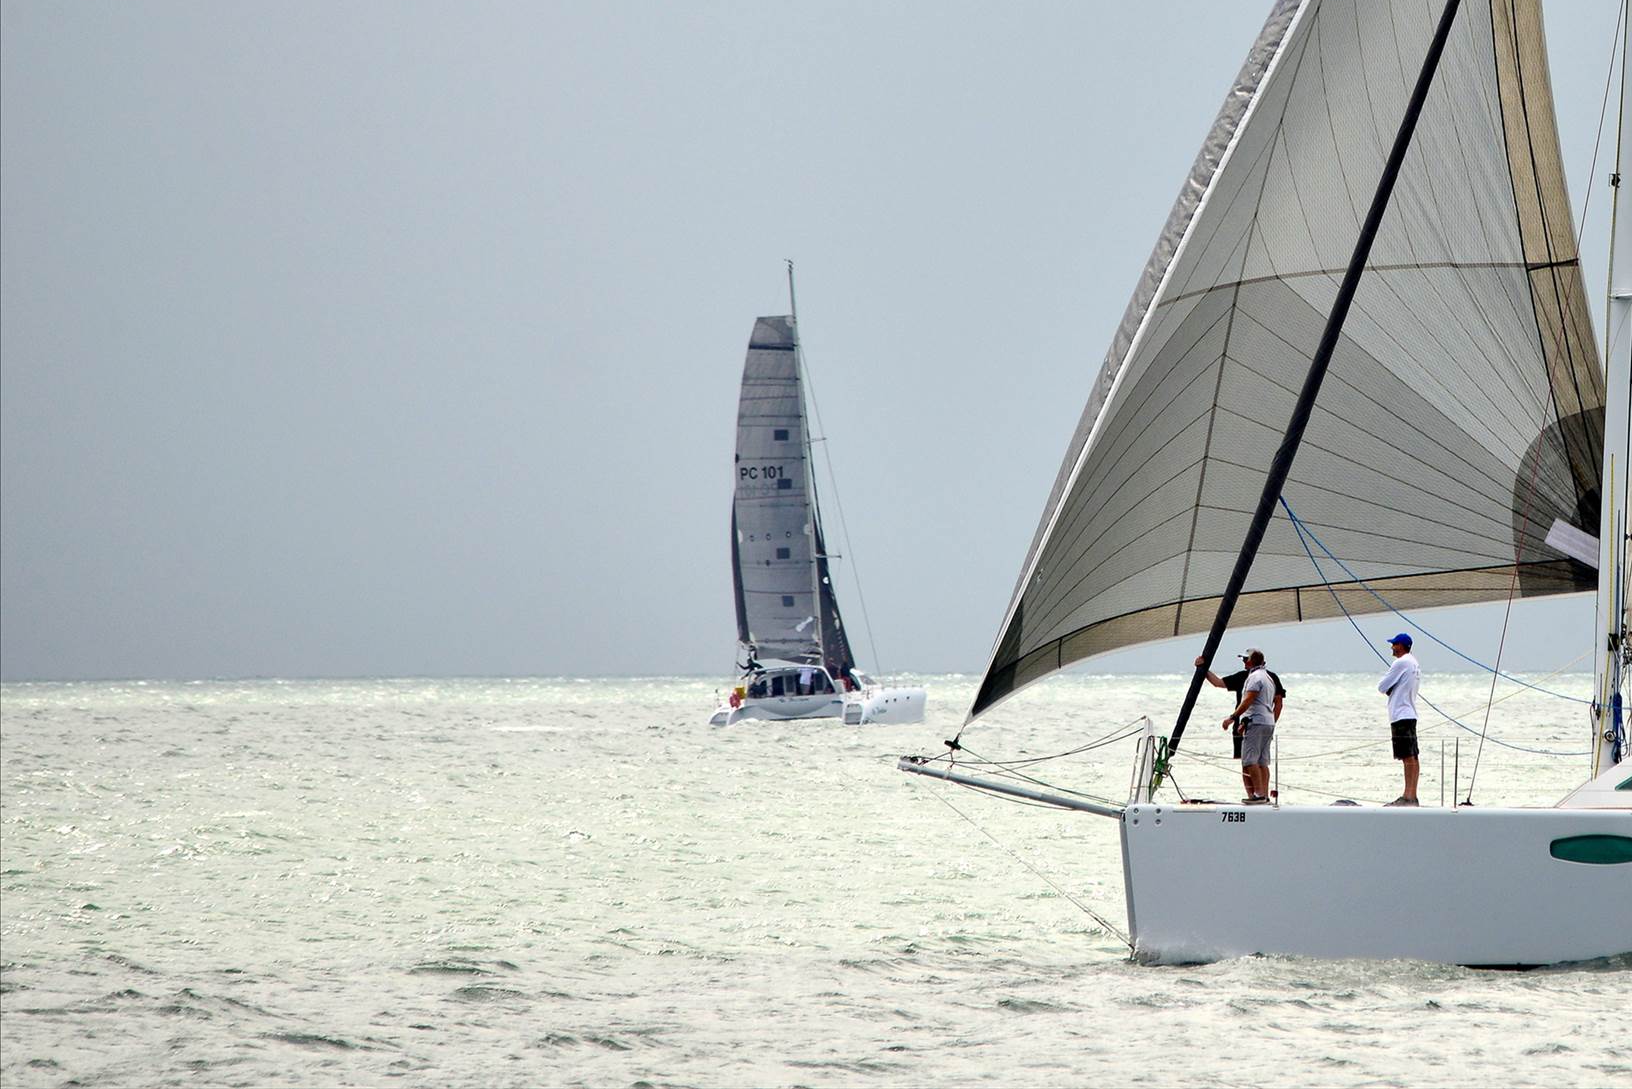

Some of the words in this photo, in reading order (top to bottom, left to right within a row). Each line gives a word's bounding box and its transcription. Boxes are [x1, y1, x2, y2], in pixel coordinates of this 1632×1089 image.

[740, 467, 758, 480] PC
[761, 466, 783, 479] 101
[1221, 811, 1246, 823] 7638
